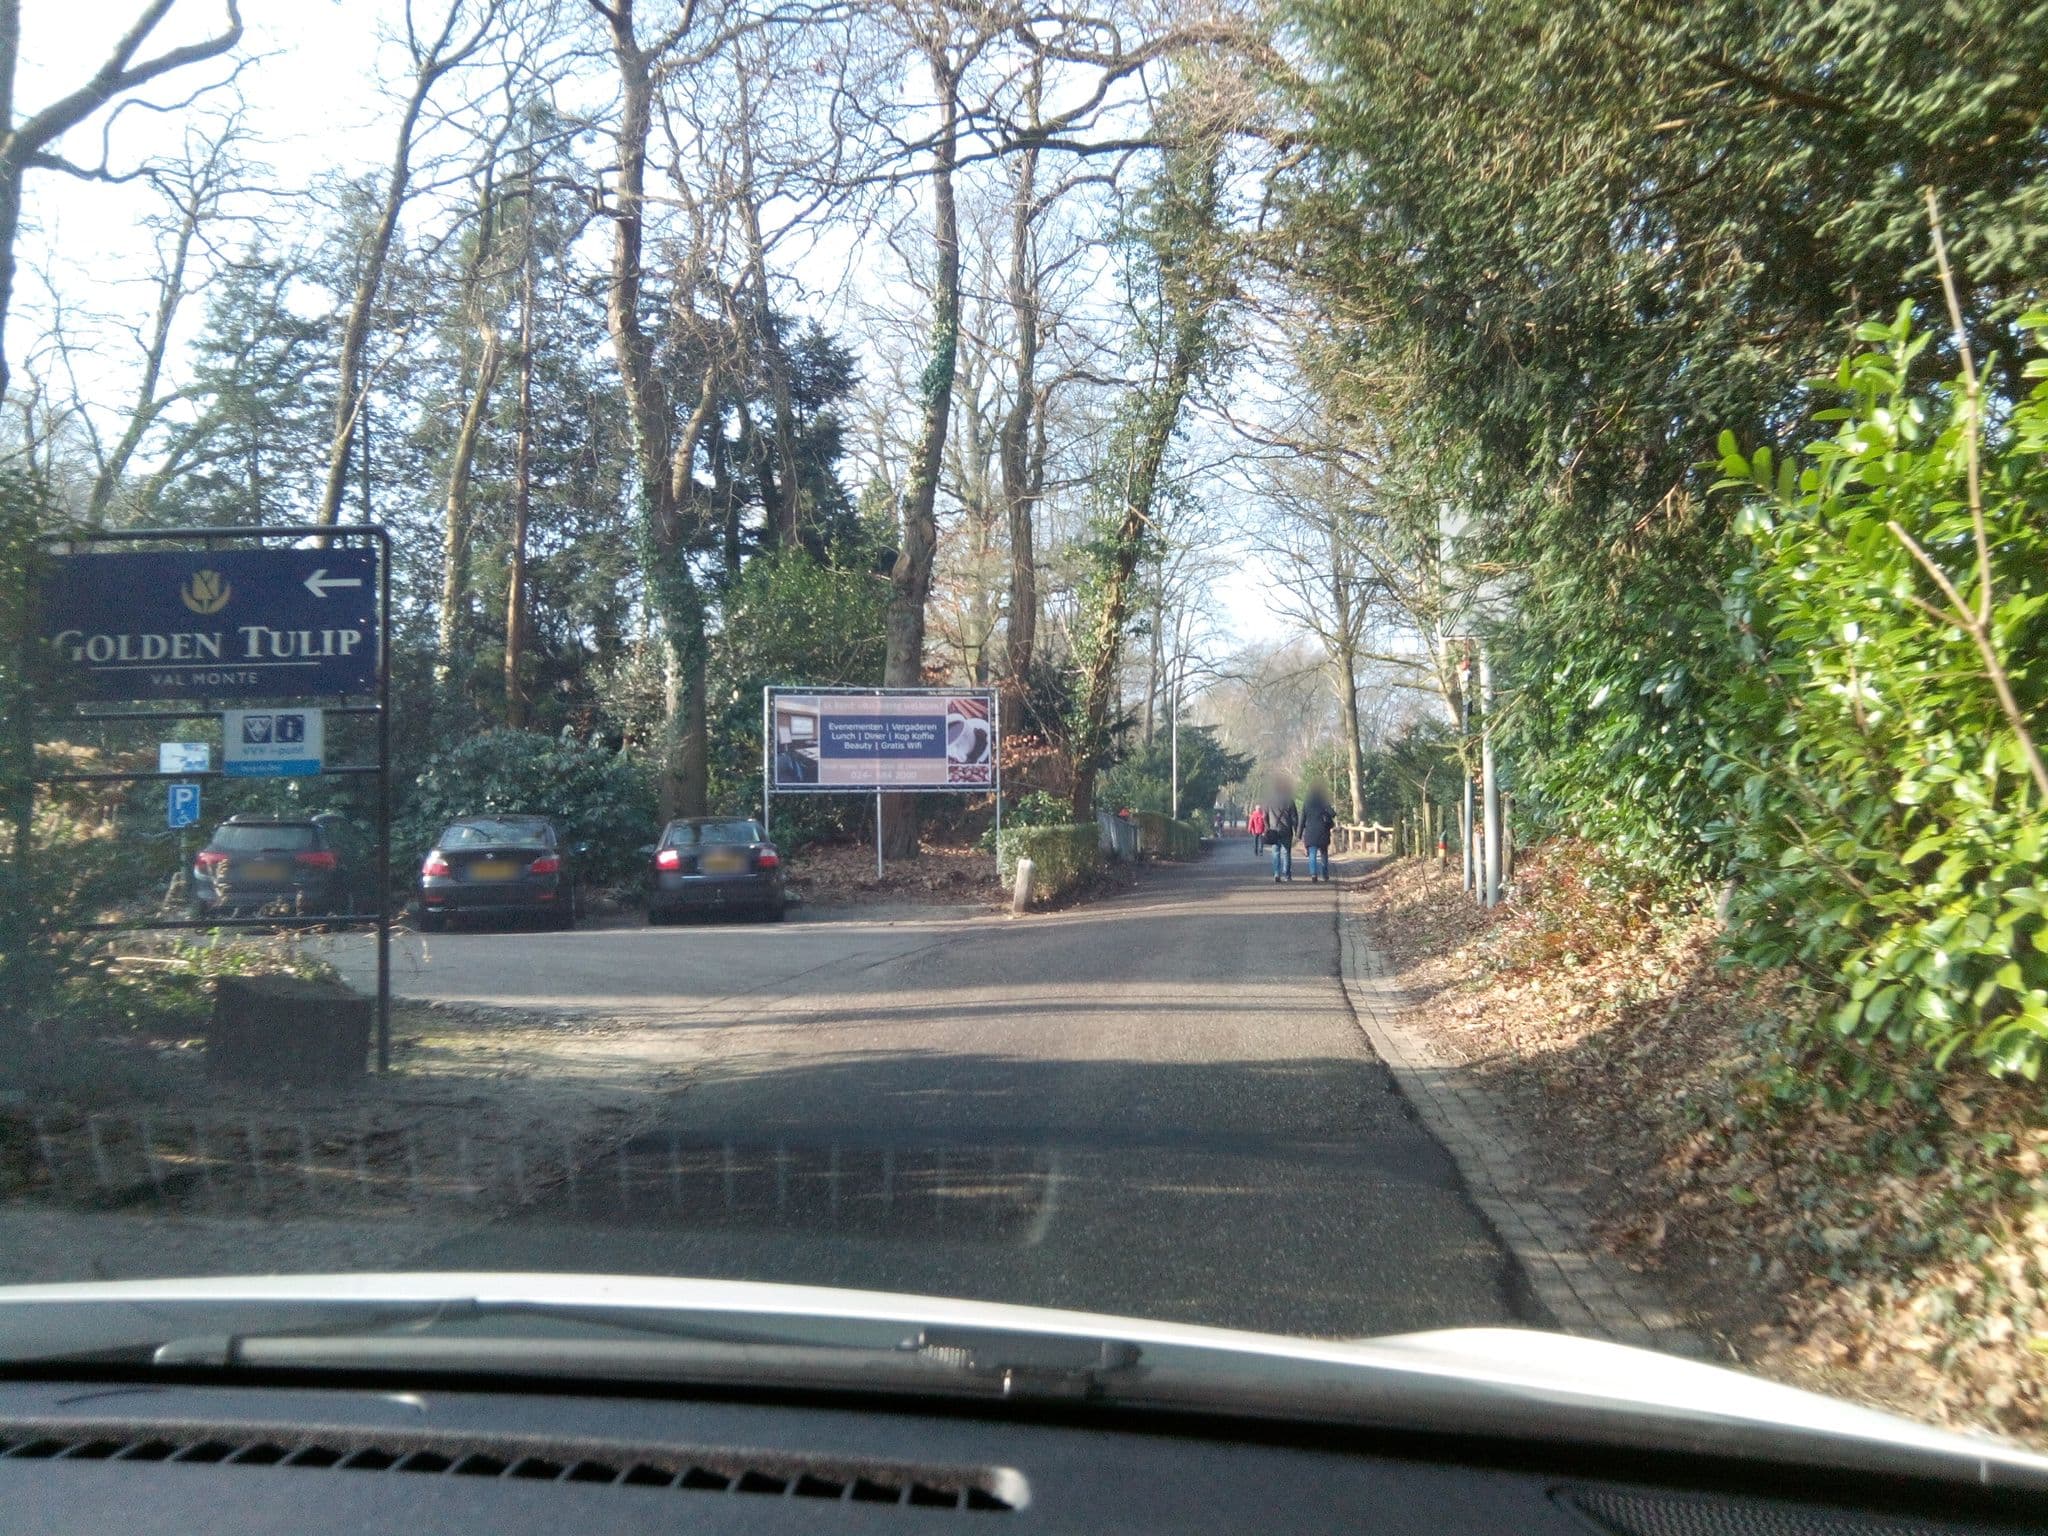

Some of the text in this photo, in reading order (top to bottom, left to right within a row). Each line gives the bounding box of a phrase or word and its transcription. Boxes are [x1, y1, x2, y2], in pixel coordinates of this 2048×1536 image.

[53, 626, 362, 662] GOLDEN TULIP
[151, 671, 258, 685] VAL MONTE
[828, 722, 937, 731] Evenementen Vergaderen
[831, 732, 935, 741] Lunch Diner Kop Koffie
[844, 741, 873, 750] Beauty
[881, 741, 905, 750] Gratis
[176, 788, 193, 810] P
